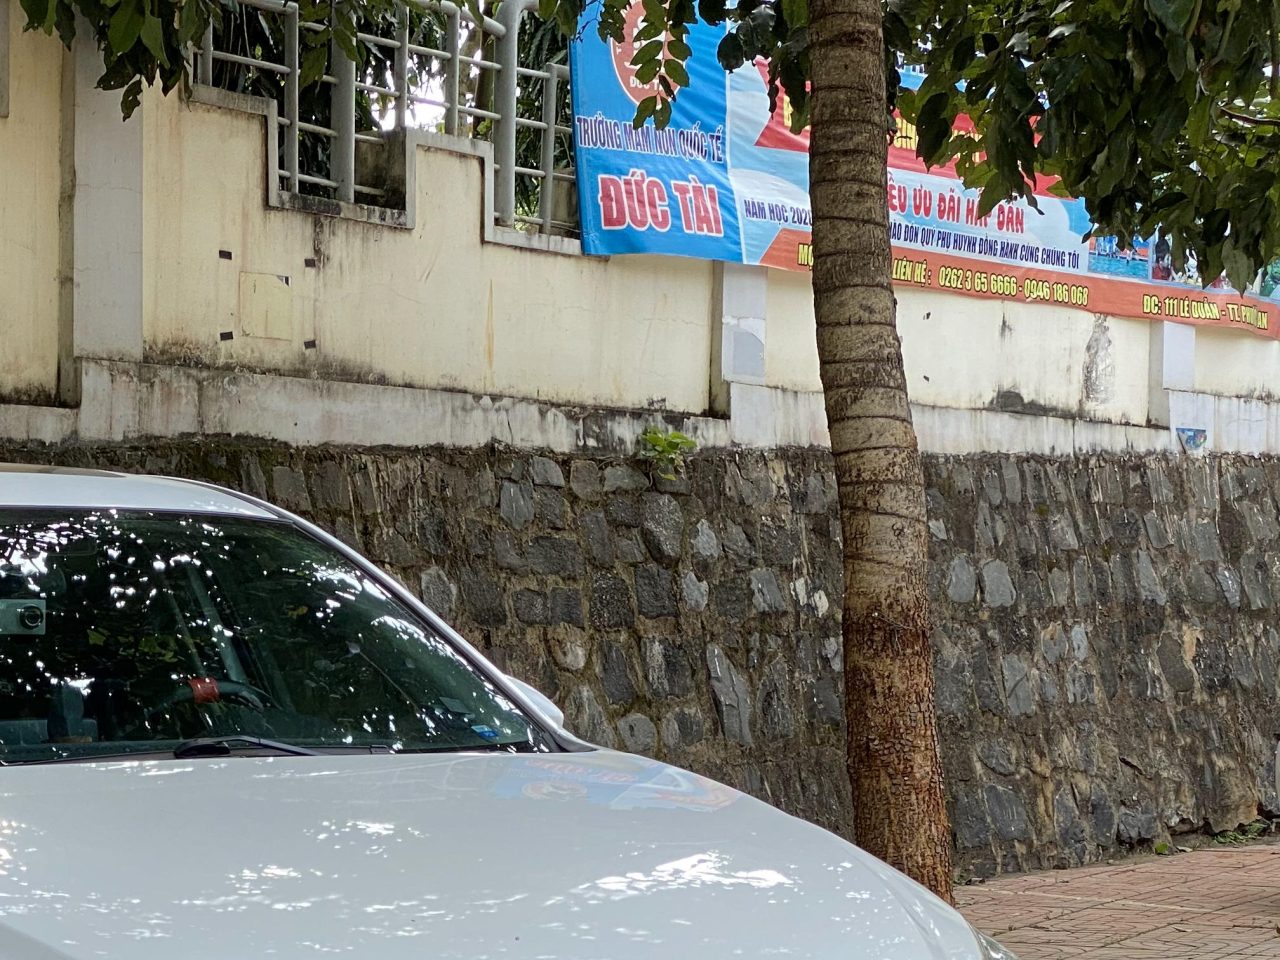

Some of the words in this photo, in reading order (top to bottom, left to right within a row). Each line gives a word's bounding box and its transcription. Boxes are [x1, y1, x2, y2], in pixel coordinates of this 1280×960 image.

[577, 111, 622, 149] TRƯỜNG
[678, 121, 707, 160] QUỐC
[708, 125, 723, 163] TẾ
[598, 168, 671, 232] ĐỨC
[671, 174, 724, 237] TÀI
[767, 202, 789, 225] HỌC
[937, 187, 960, 224] ĐÃI
[903, 223, 919, 244] ĐÓN
[920, 225, 936, 247] QUÝ
[936, 230, 952, 252] PHỤ
[952, 233, 978, 254] HUYNH
[978, 233, 999, 257] ĐỒNG
[892, 256, 913, 283] LIÊN
[938, 264, 963, 288] 0262
[964, 269, 972, 291] 3
[973, 271, 988, 293] 65
[990, 273, 1017, 296] 6666
[1023, 277, 1051, 301] 0946
[1052, 282, 1069, 304] 186
[1070, 285, 1089, 306] 068
[1164, 296, 1179, 316] 111
